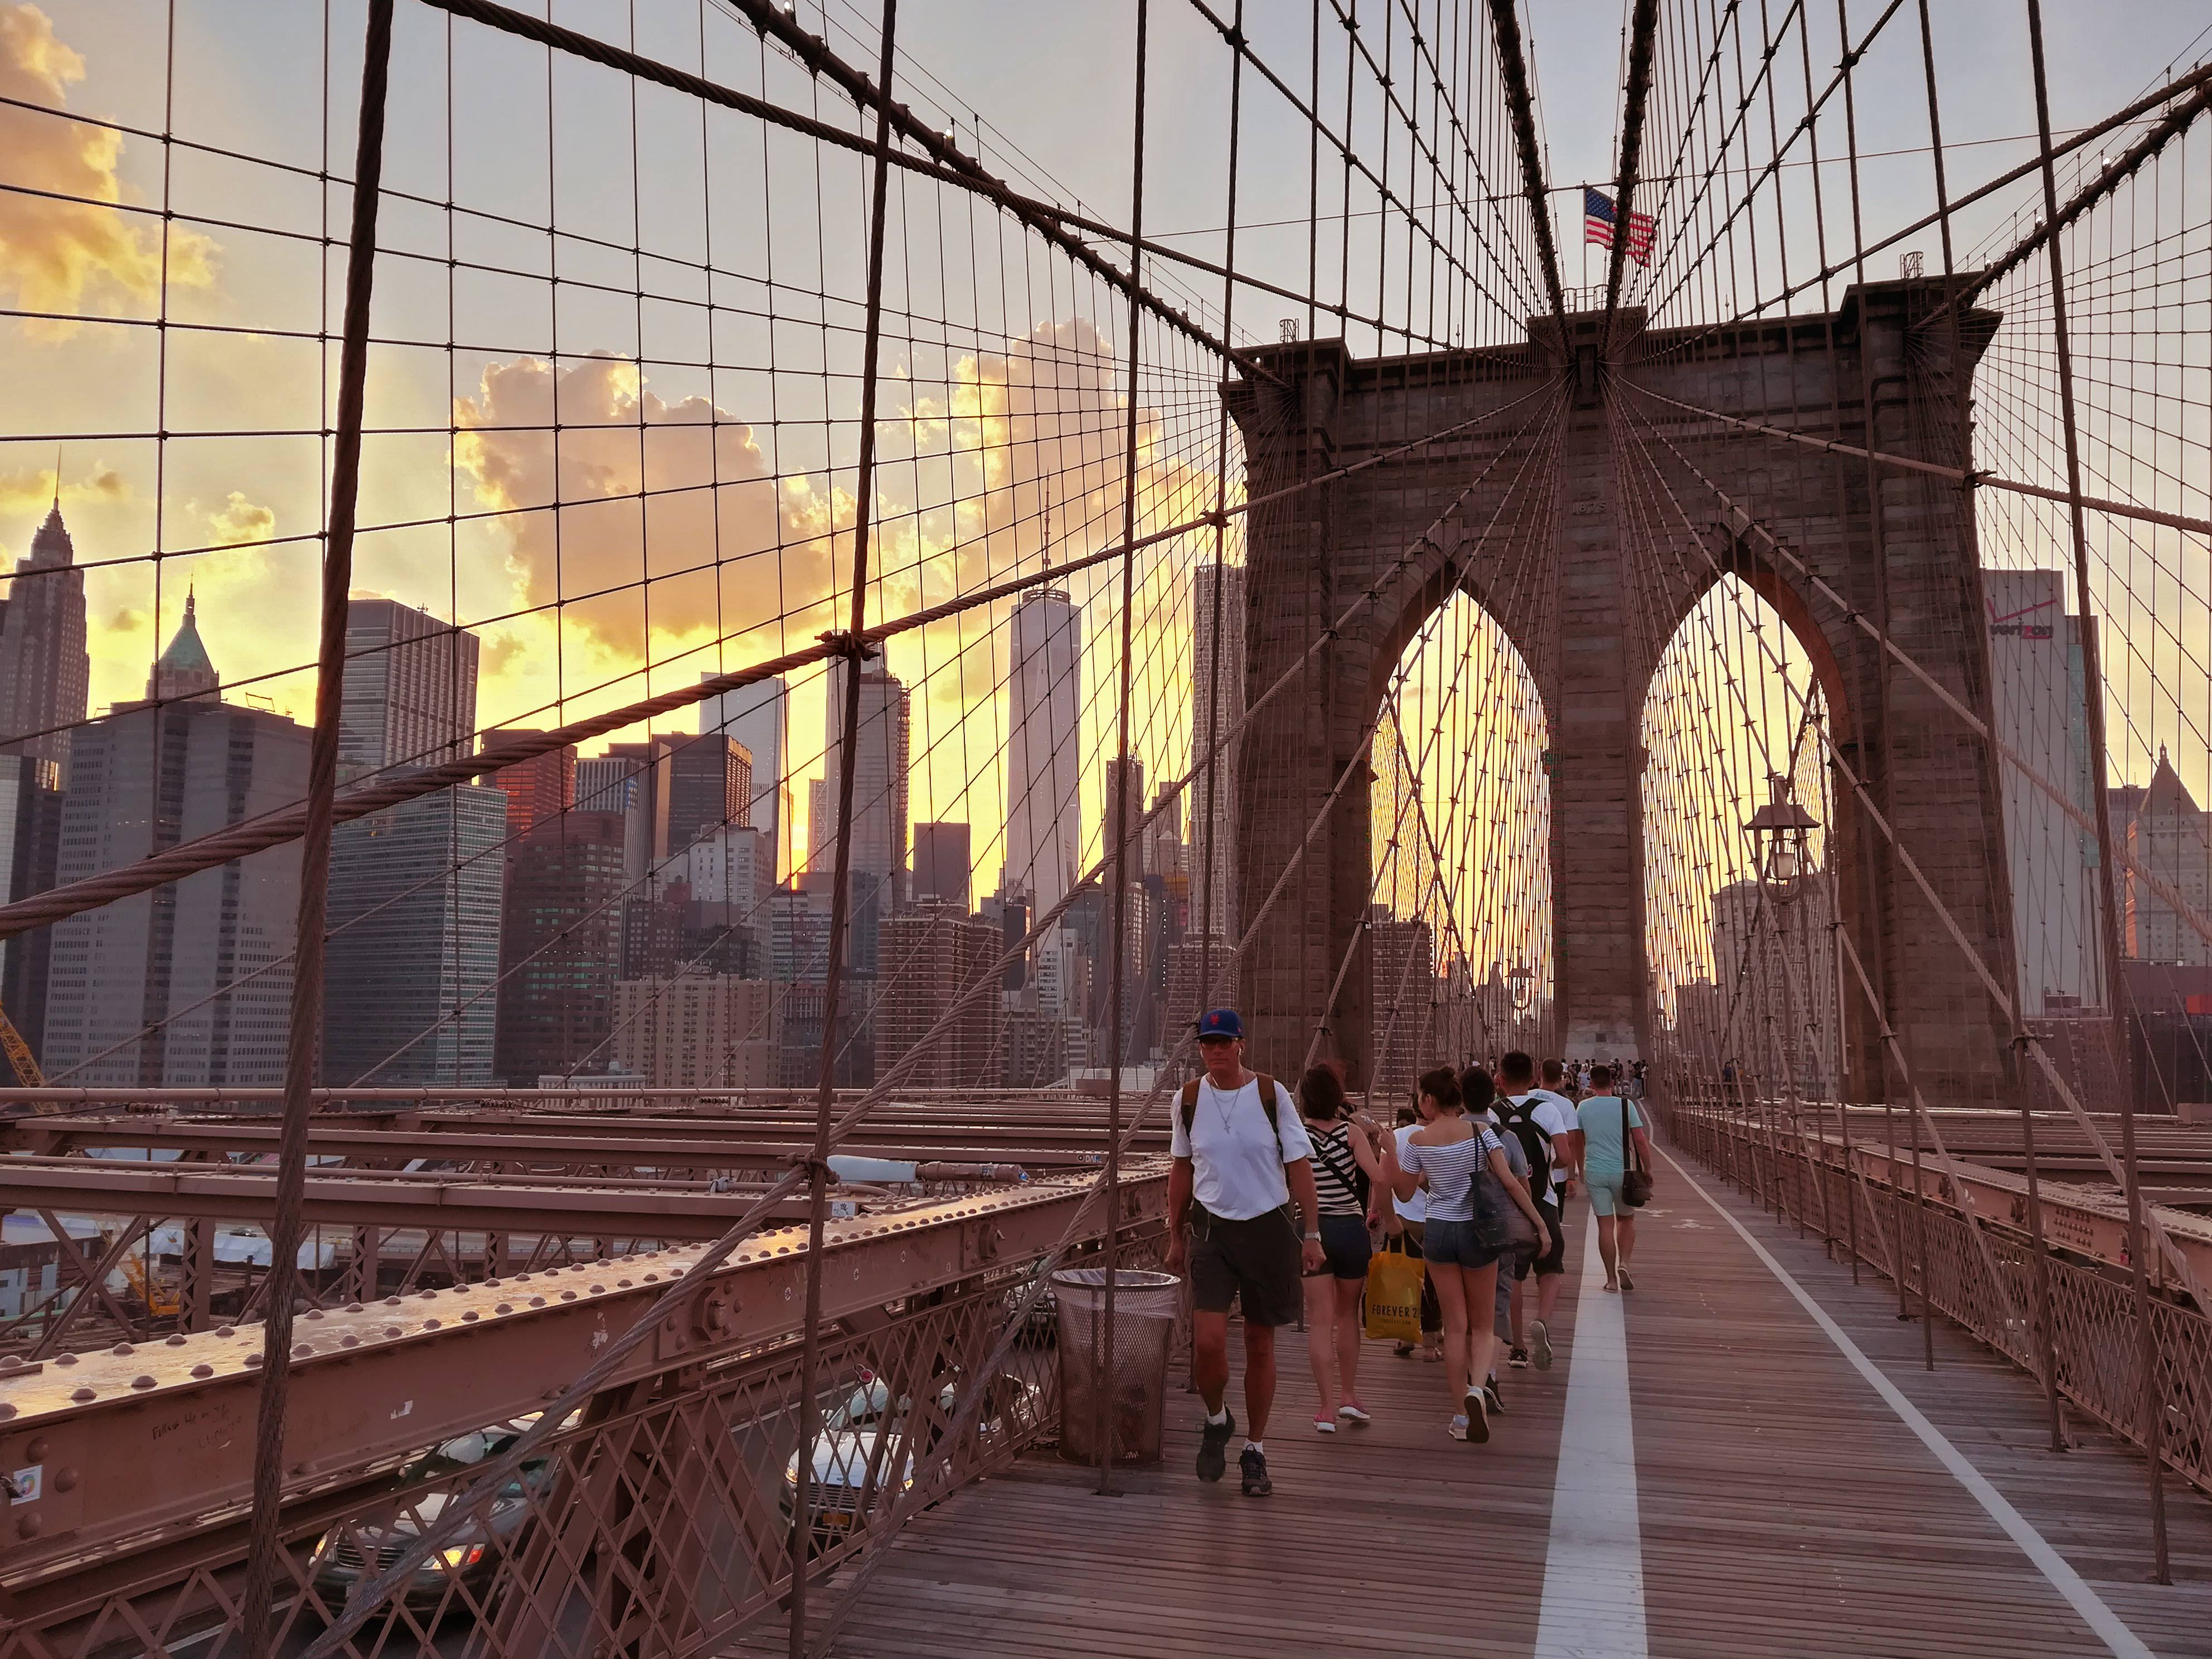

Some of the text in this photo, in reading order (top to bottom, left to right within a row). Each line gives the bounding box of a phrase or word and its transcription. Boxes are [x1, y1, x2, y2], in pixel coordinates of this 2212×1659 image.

[1573, 501, 1606, 513] 1875
[1990, 624, 2054, 639] verizon
[1372, 1304, 1410, 1317] FOREVER
